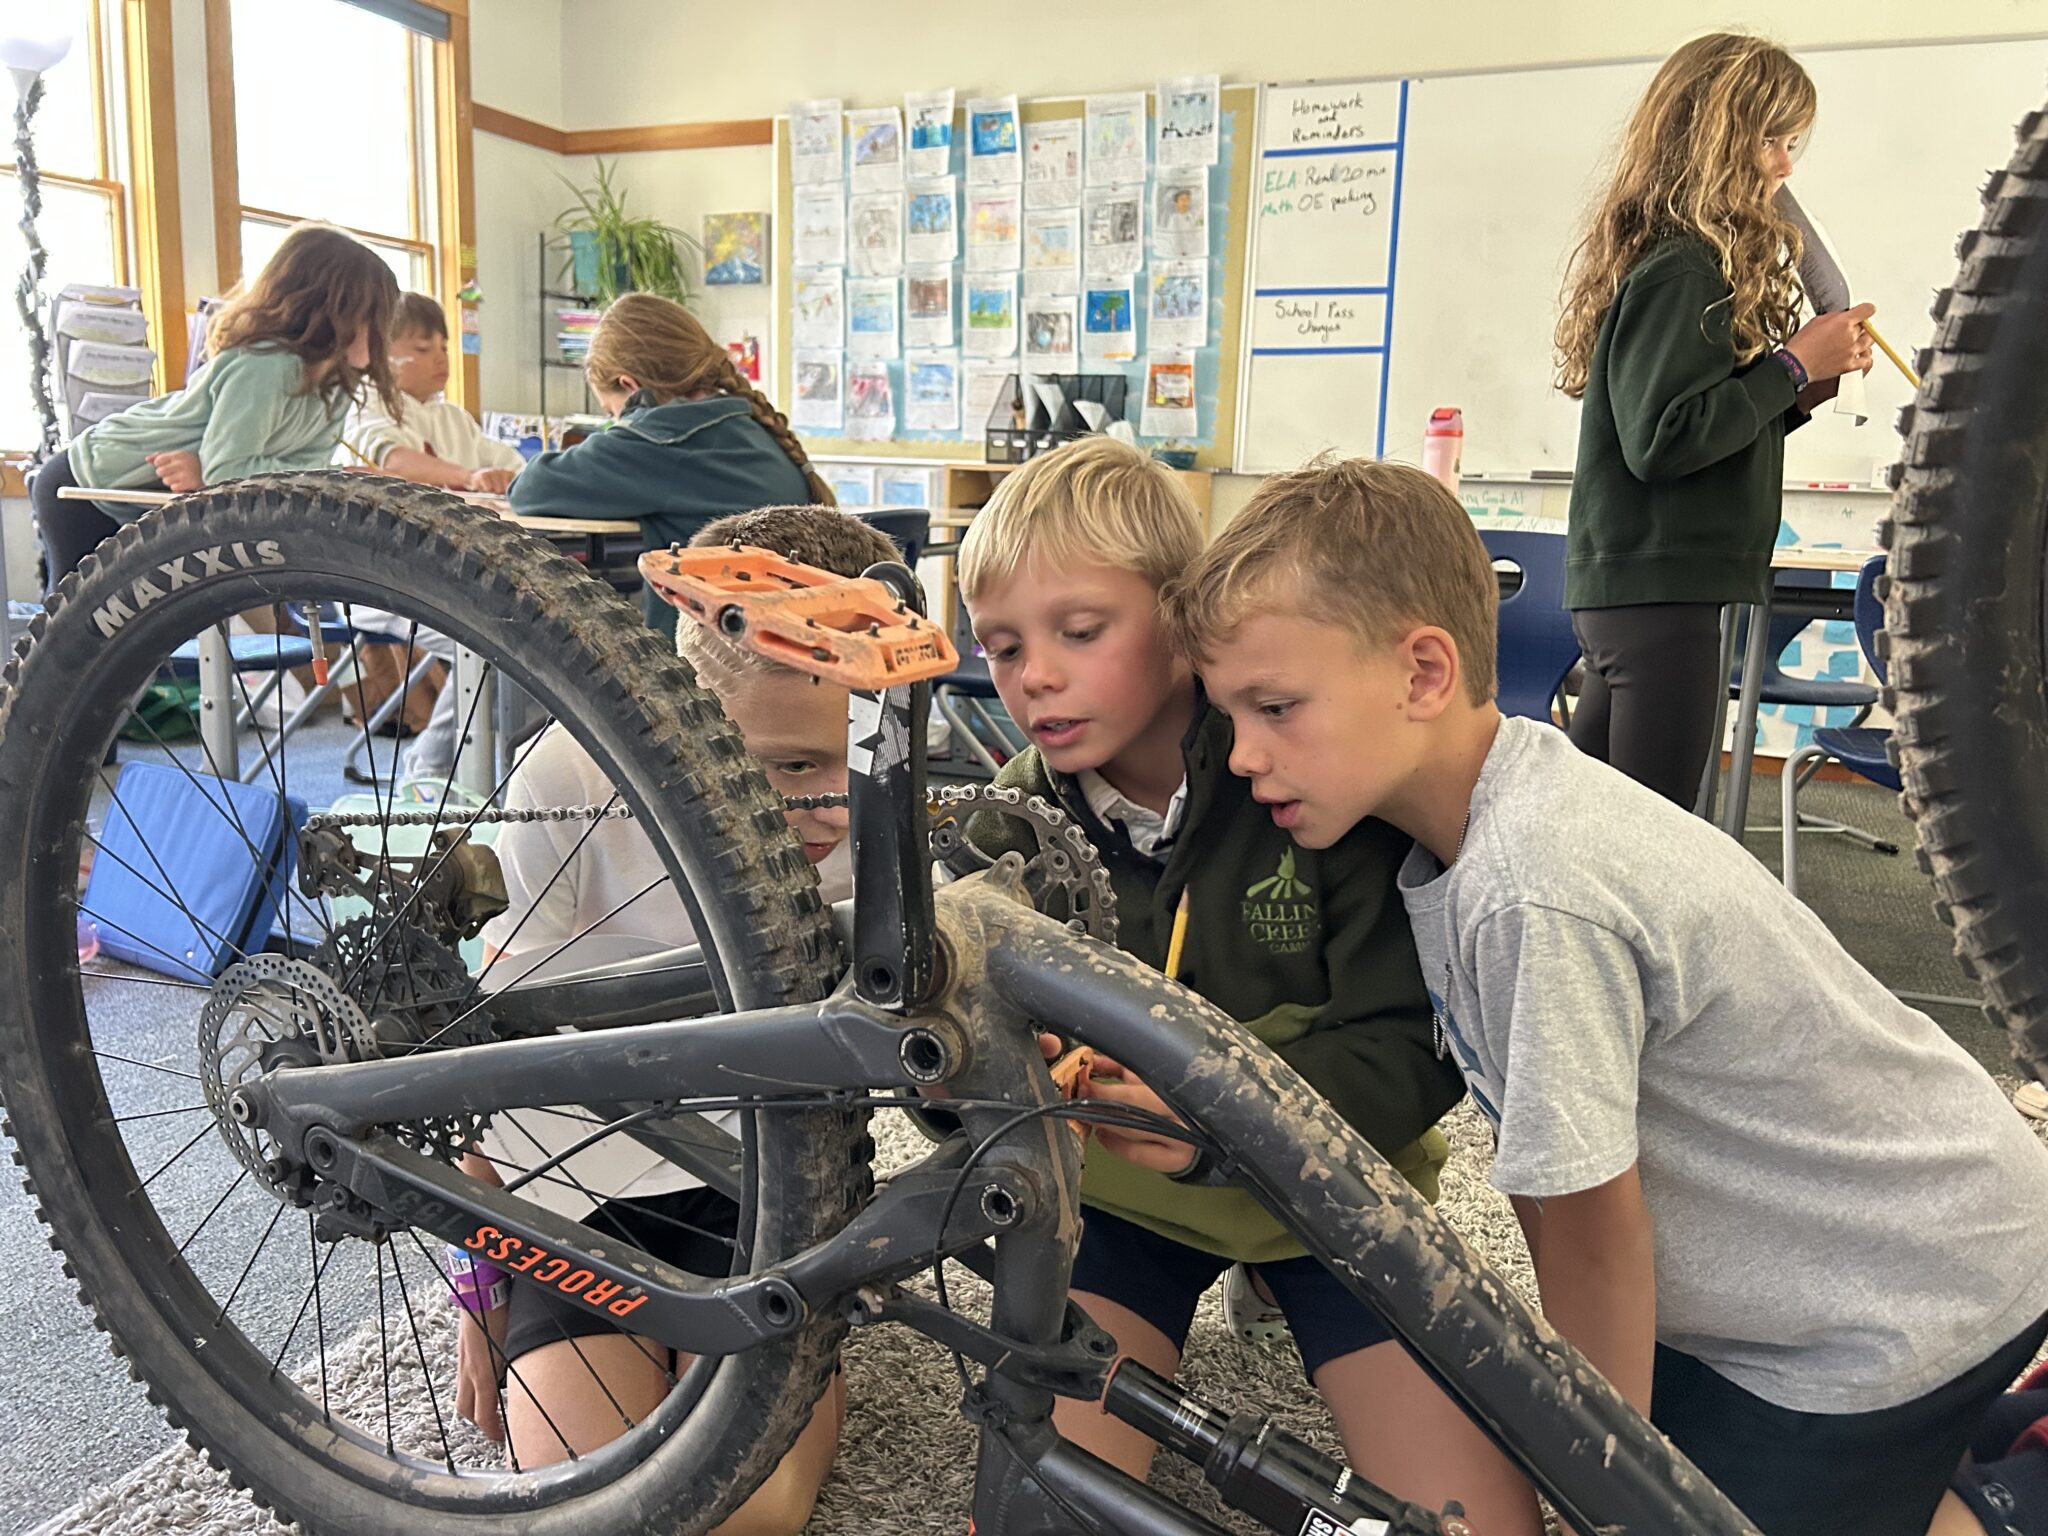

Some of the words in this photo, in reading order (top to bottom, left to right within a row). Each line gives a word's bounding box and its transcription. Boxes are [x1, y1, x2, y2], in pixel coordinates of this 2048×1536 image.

[1292, 92, 1364, 117] Homework
[1318, 112, 1338, 124] and
[1292, 124, 1365, 143] Reminders
[1264, 170, 1297, 193] ELA
[1340, 166, 1364, 183] 20
[1274, 299, 1319, 319] School
[1327, 301, 1355, 319] Pass
[92, 539, 286, 639] MAXXIS
[464, 1226, 648, 1317] PROCESS
